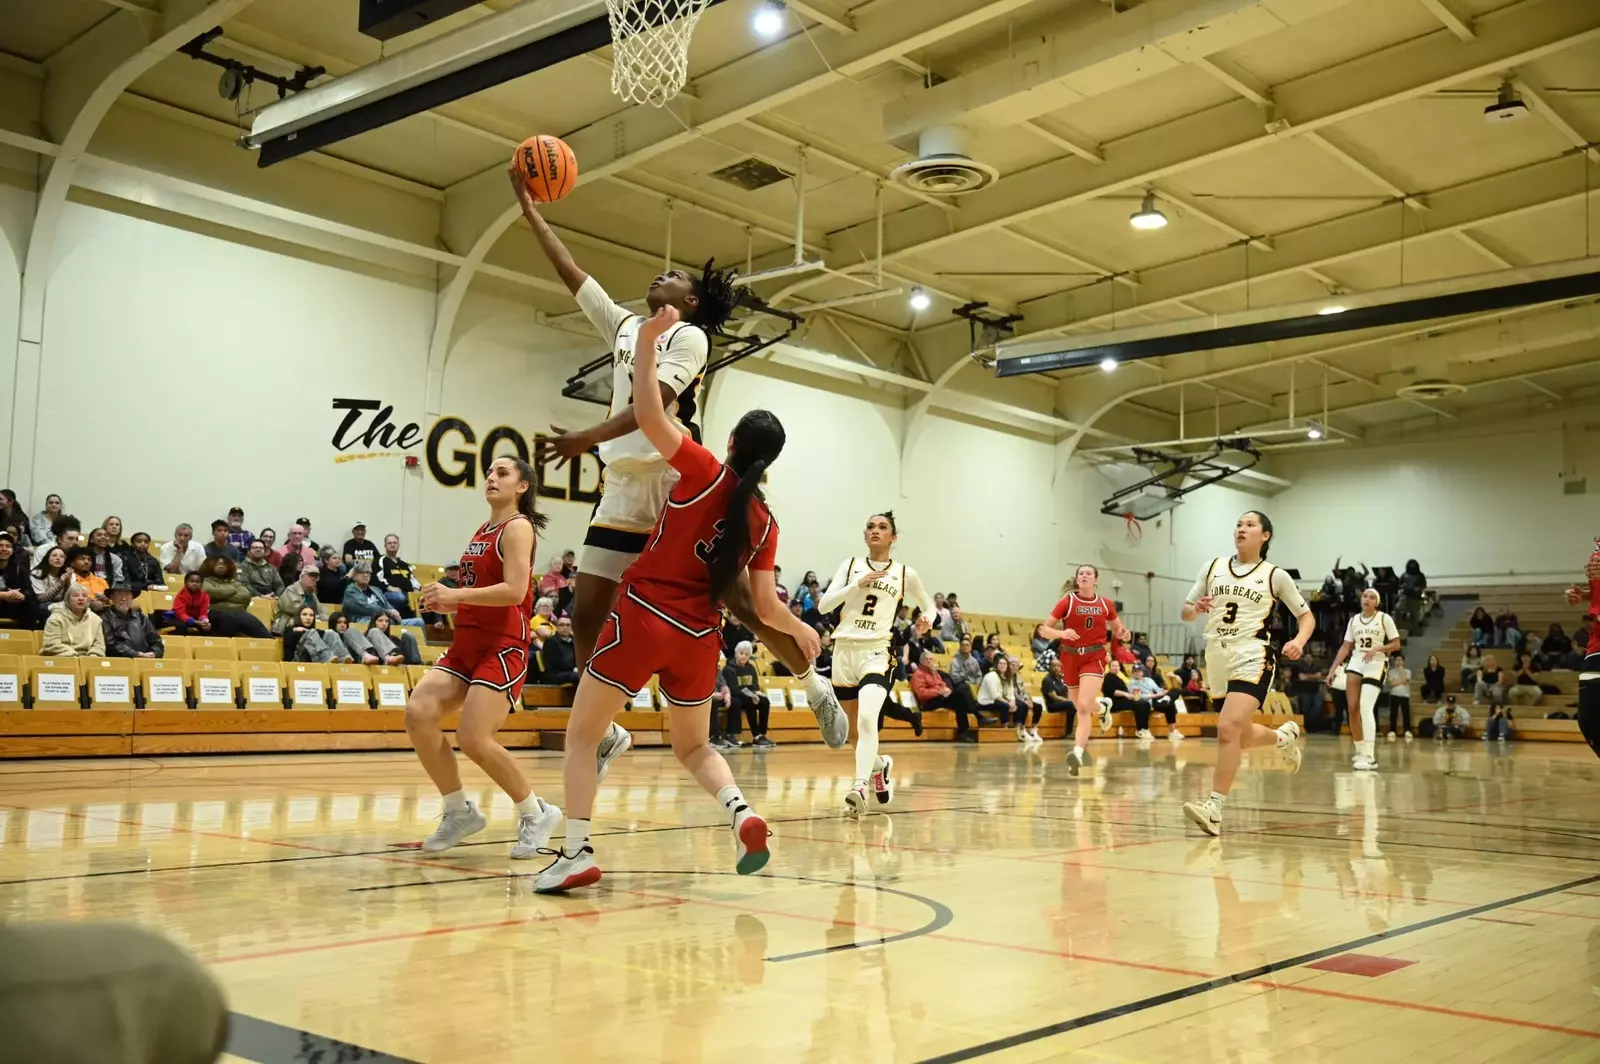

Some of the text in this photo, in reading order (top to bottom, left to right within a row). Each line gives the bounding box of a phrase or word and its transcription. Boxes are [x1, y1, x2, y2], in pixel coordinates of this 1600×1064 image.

[524, 147, 539, 179] NCAA
[543, 140, 559, 181] Wilson
[332, 398, 602, 504] The GOLD
[463, 541, 492, 557] SUN
[1211, 585, 1263, 604] LONG BEACH
[862, 594, 878, 616] 2
[1076, 605, 1102, 616] CSUN
[1222, 602, 1239, 624] 3
[854, 619, 877, 630] STATE
[1085, 616, 1094, 630] 0
